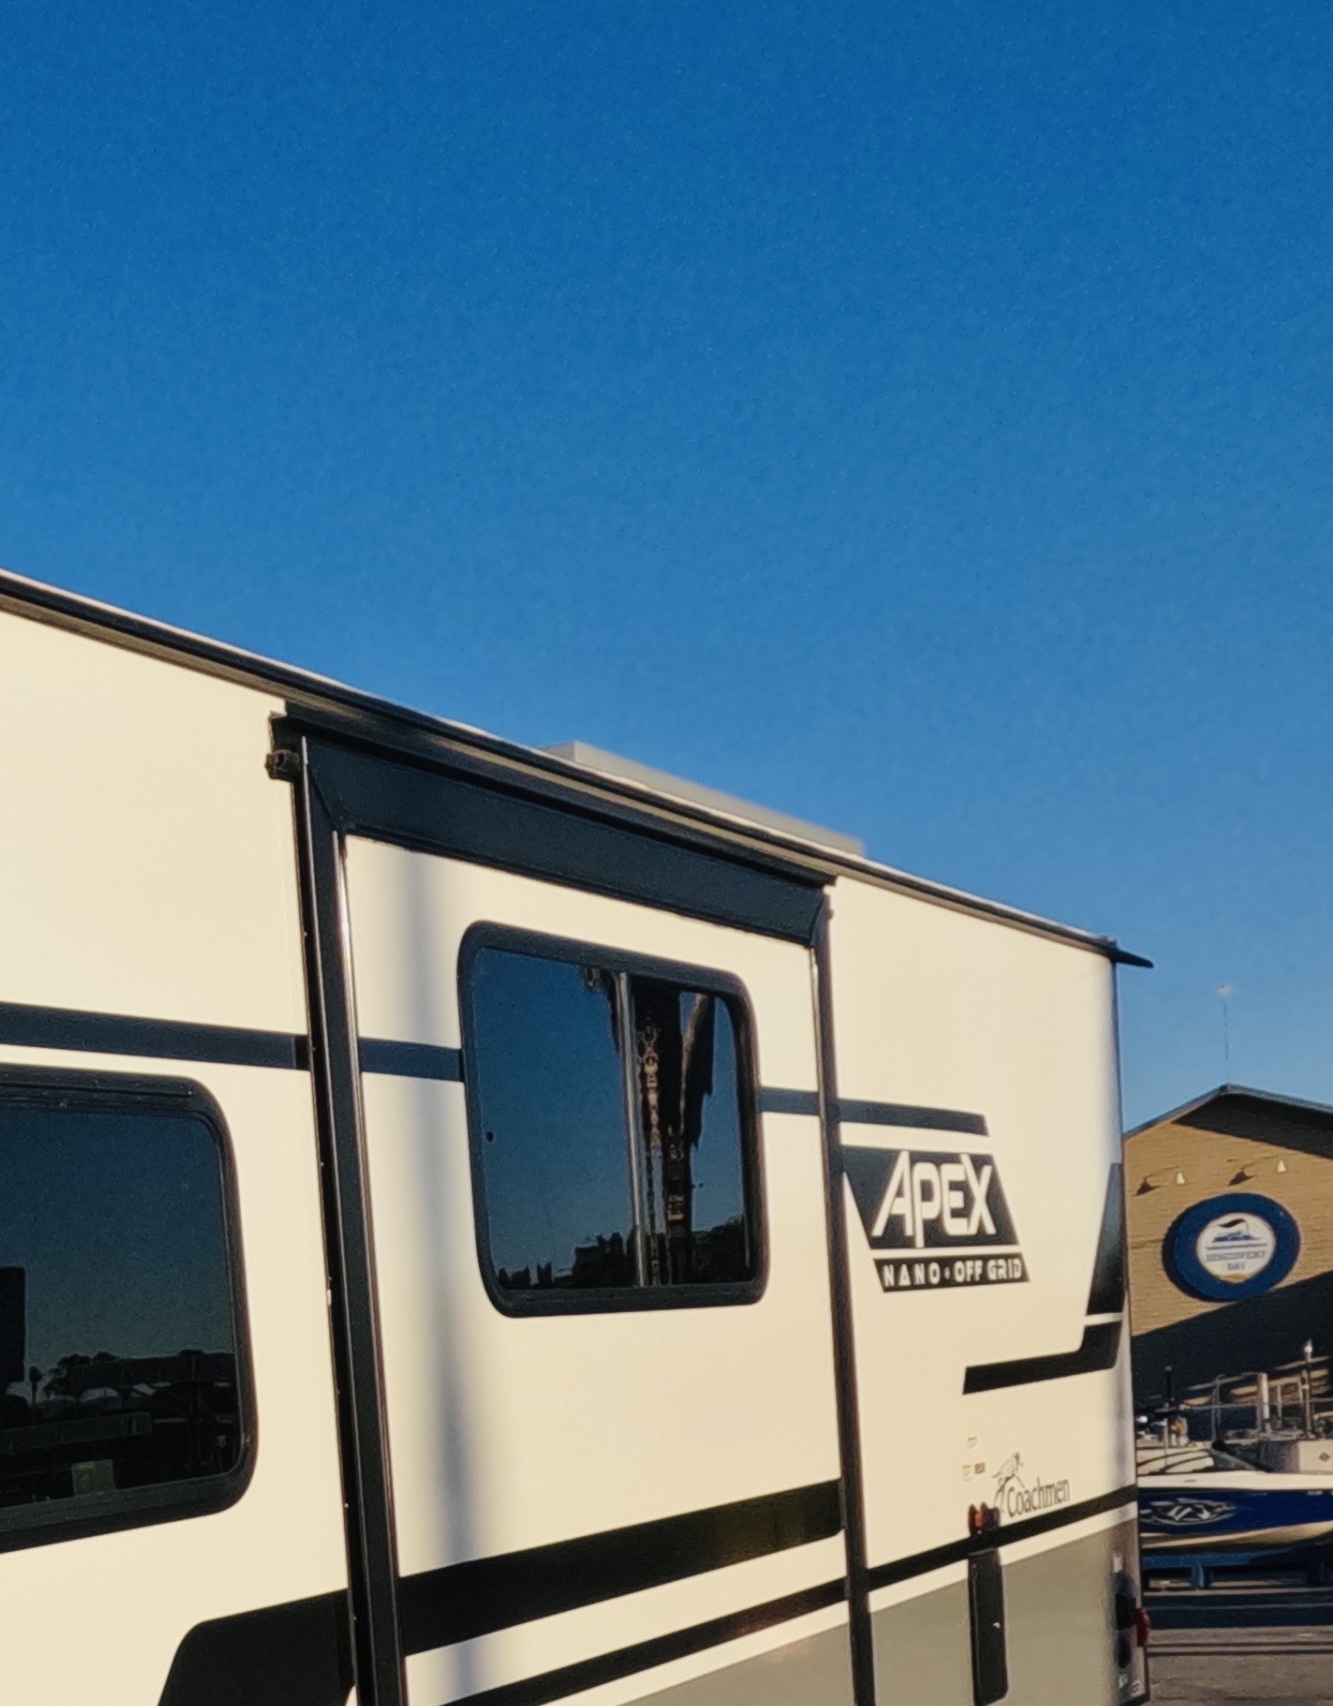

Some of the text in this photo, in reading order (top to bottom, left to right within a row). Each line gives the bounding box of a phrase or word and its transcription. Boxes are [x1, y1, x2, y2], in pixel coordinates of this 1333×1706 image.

[871, 1150, 997, 1248] APEX
[884, 1257, 1023, 1287] NANO OFF GRID
[1006, 1476, 1071, 1518] Coachmen
